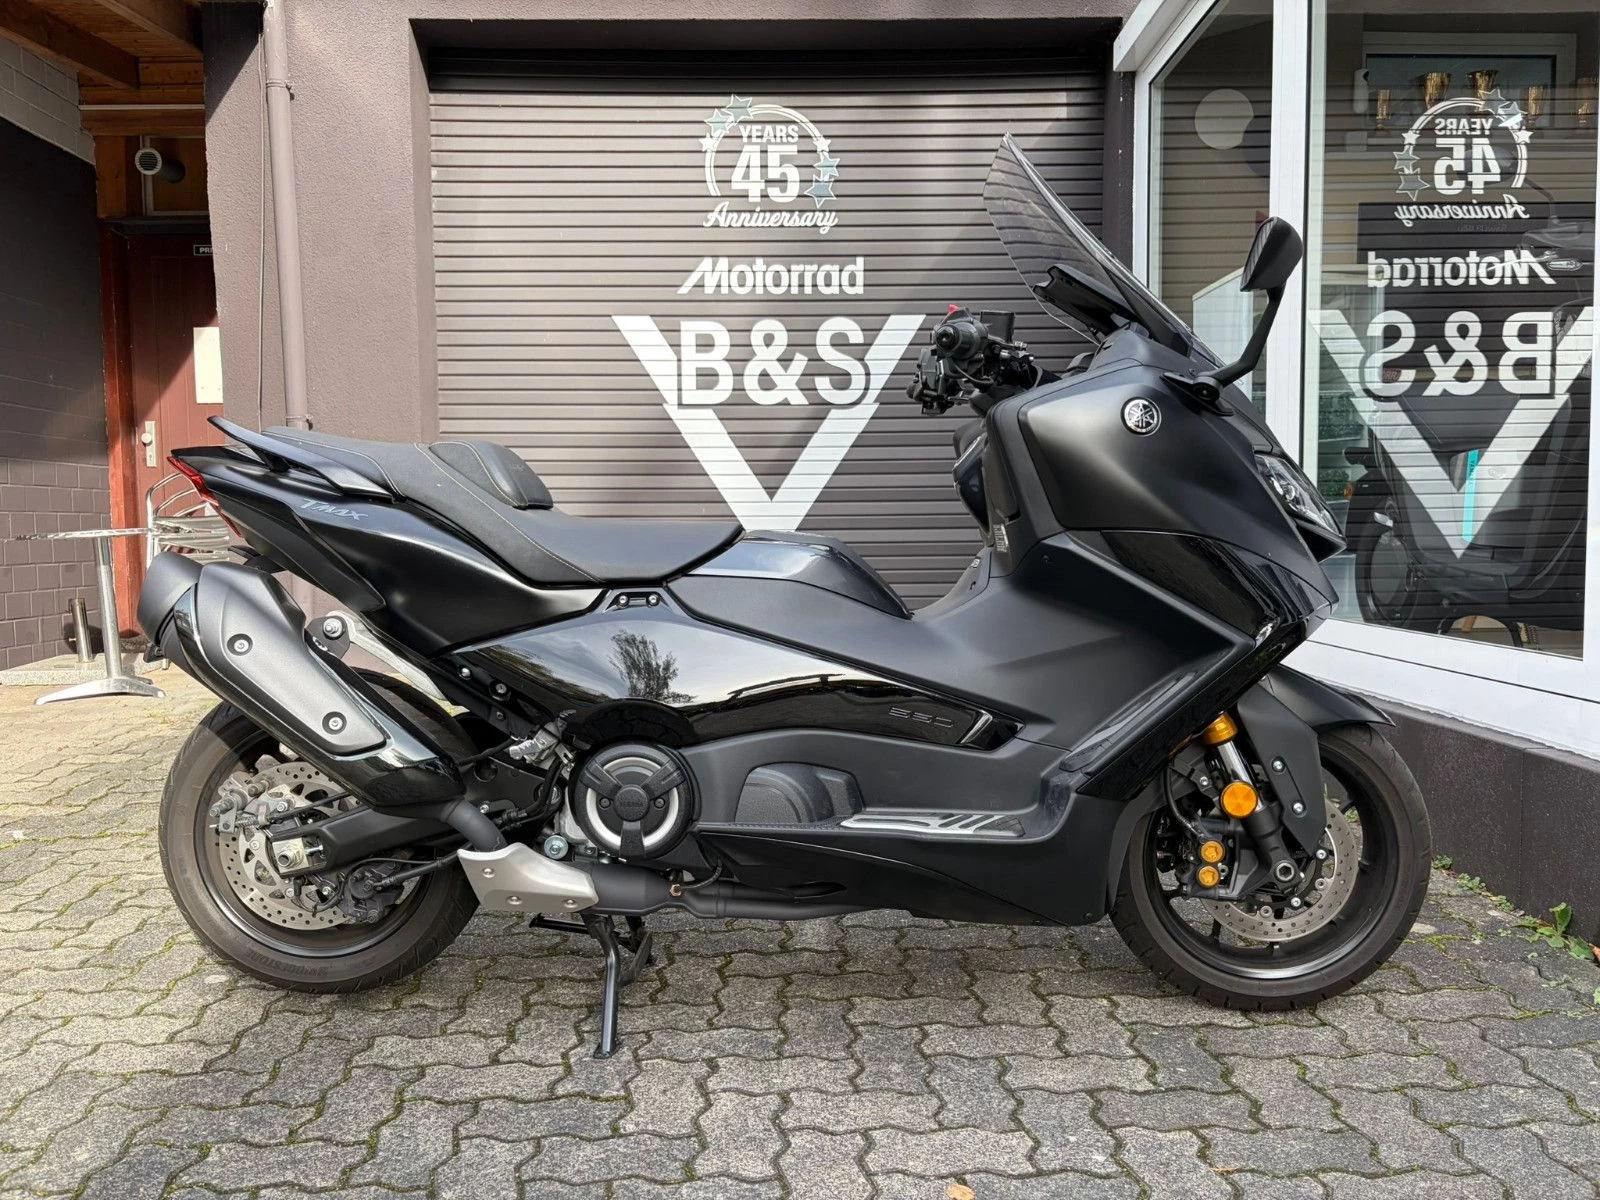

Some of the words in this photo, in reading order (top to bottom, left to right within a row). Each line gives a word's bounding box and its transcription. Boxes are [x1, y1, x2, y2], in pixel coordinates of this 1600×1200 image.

[740, 125, 799, 143] YEARS
[730, 145, 800, 202] 45
[703, 201, 838, 234] Anniversary
[677, 256, 864, 295] Motorrad
[680, 316, 866, 405] B&S
